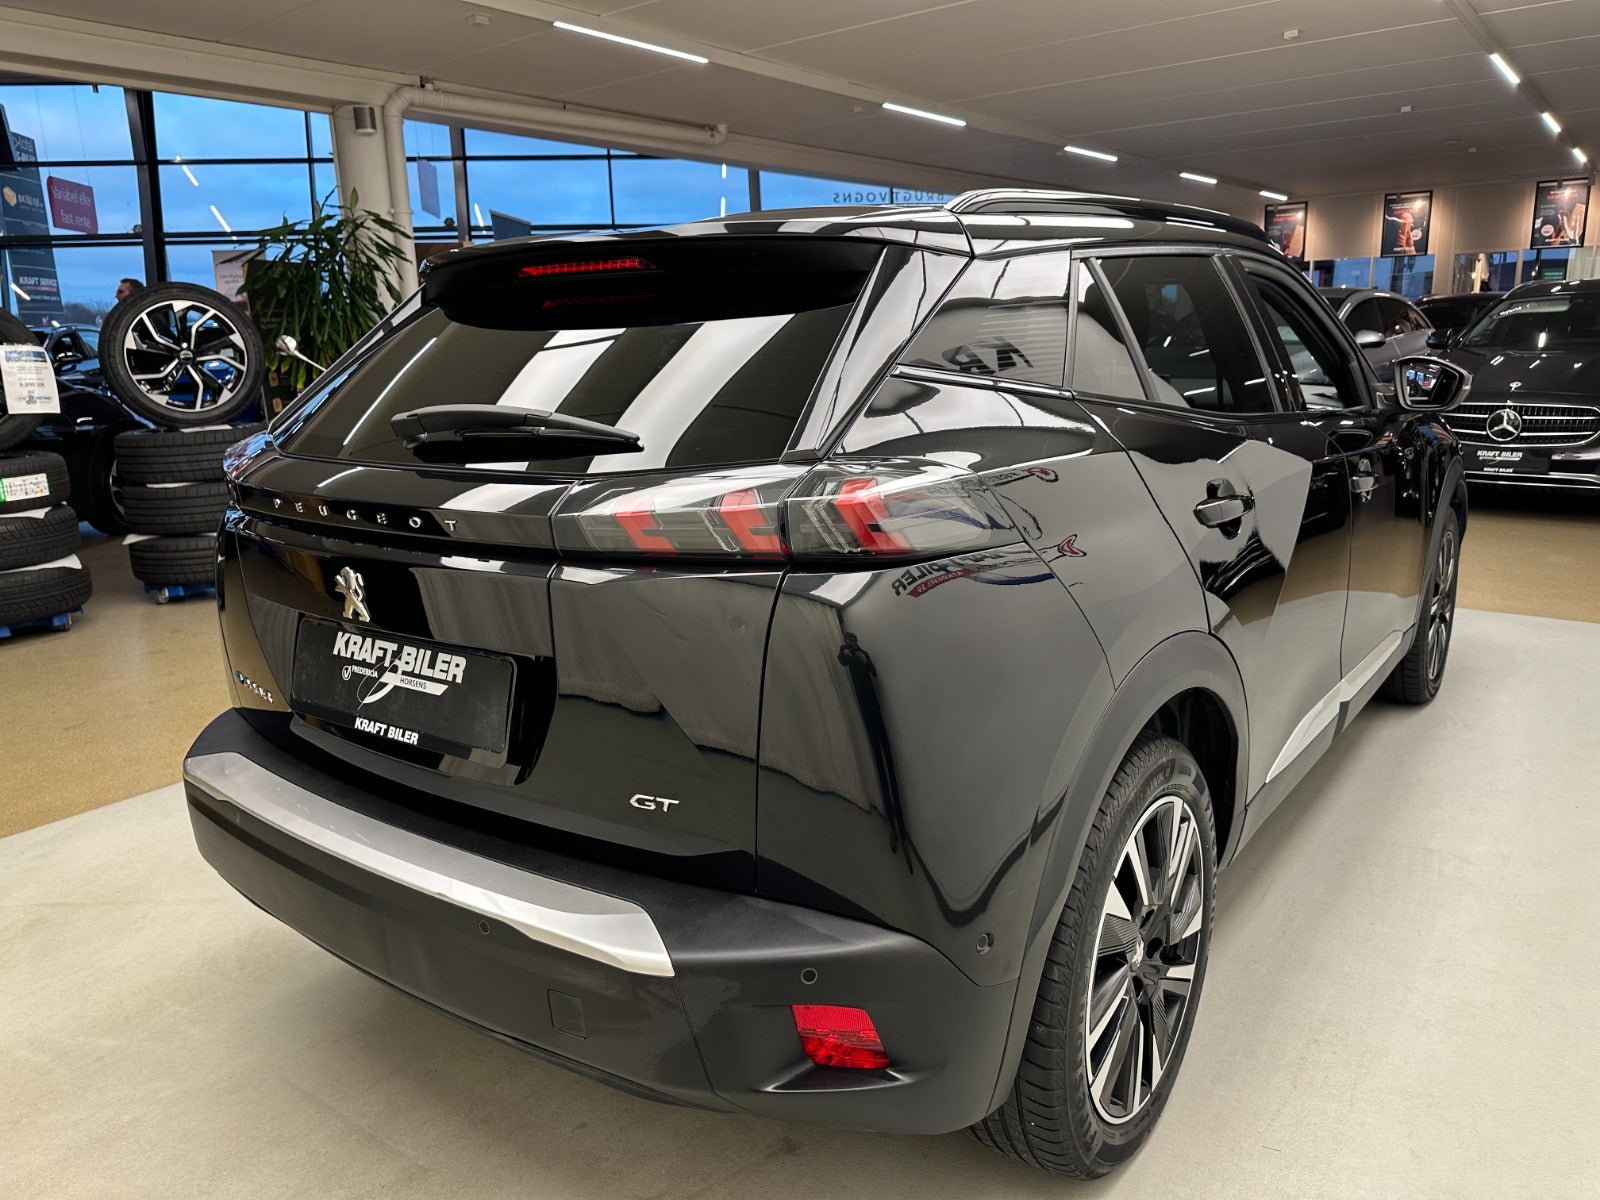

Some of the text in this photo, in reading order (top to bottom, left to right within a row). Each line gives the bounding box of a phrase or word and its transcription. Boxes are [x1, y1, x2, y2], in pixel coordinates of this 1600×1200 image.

[19, 276, 39, 285] KRAFT
[272, 498, 457, 532] PEUGEOT
[332, 631, 467, 684] KRAFT BILER
[352, 664, 379, 679] FREDERICIA
[400, 677, 427, 690] HORSENS
[354, 716, 419, 745] KRAFT BILER
[629, 793, 680, 813] GT
